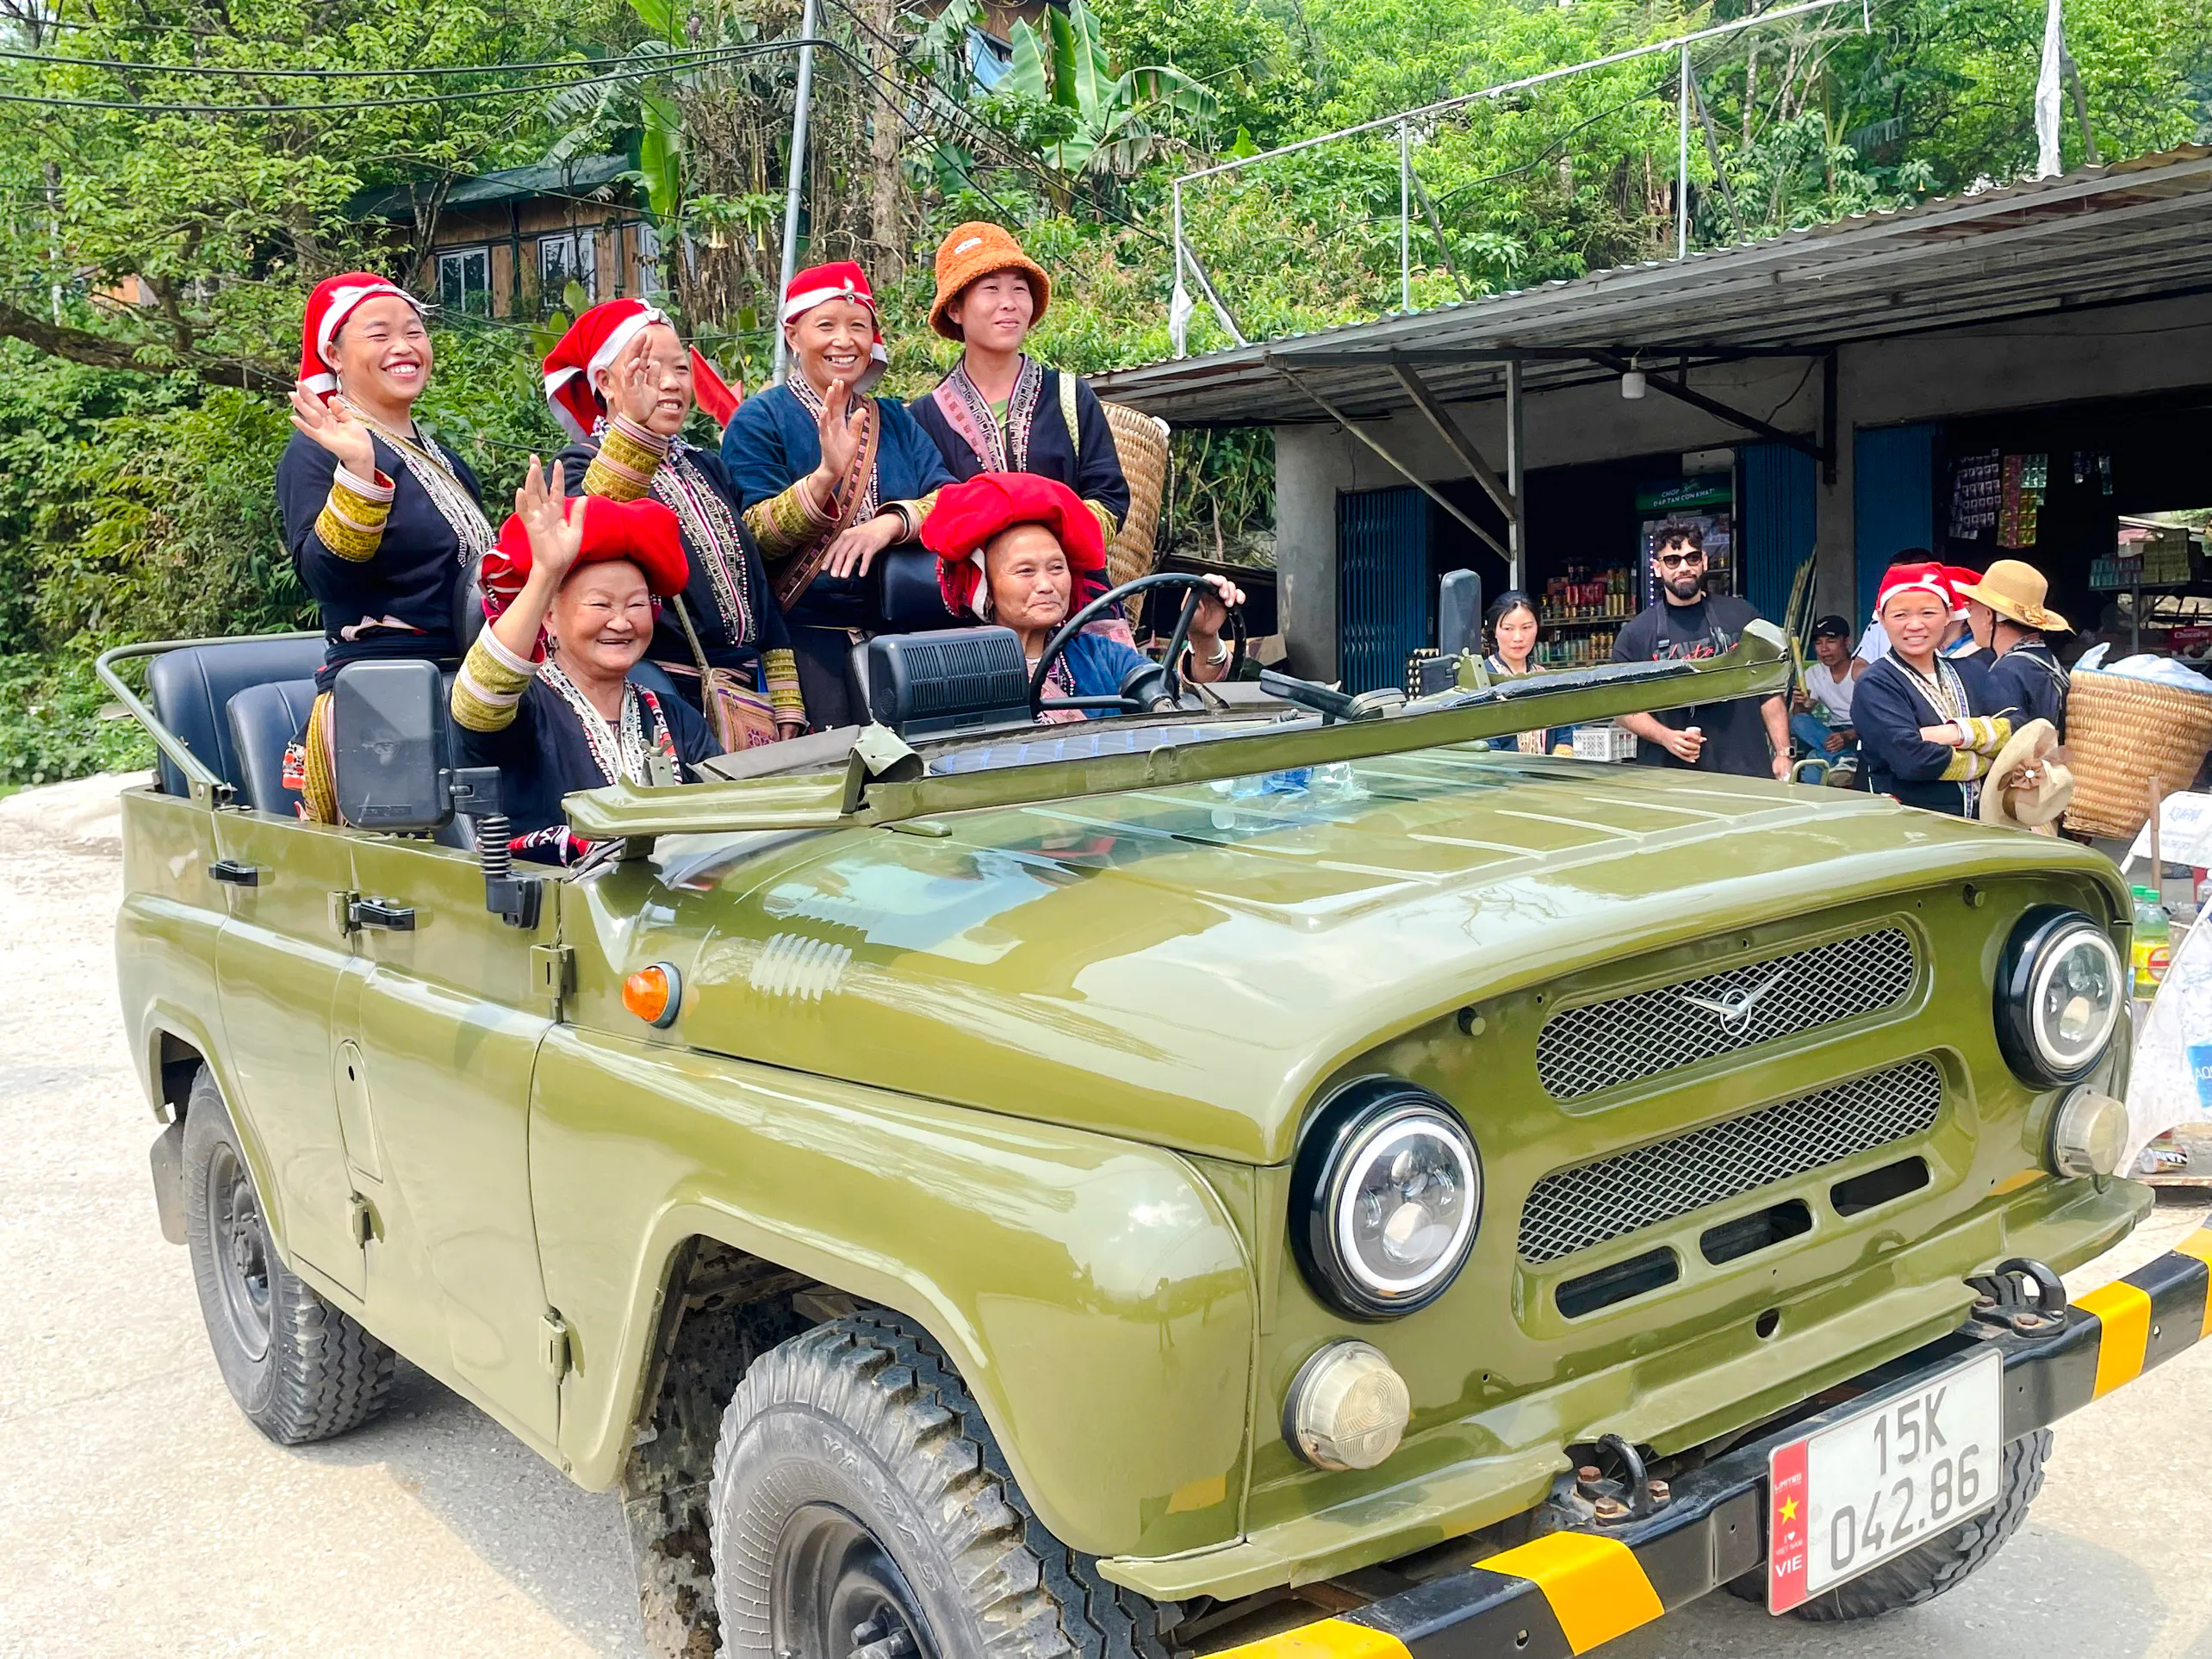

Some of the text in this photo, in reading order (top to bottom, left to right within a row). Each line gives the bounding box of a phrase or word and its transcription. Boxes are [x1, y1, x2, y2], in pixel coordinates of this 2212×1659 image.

[1873, 1385, 1948, 1476] 15K
[1774, 1473, 1802, 1491] LIMITED
[1830, 1444, 1979, 1570] 042.86
[1775, 1554, 1802, 1577] VIE
